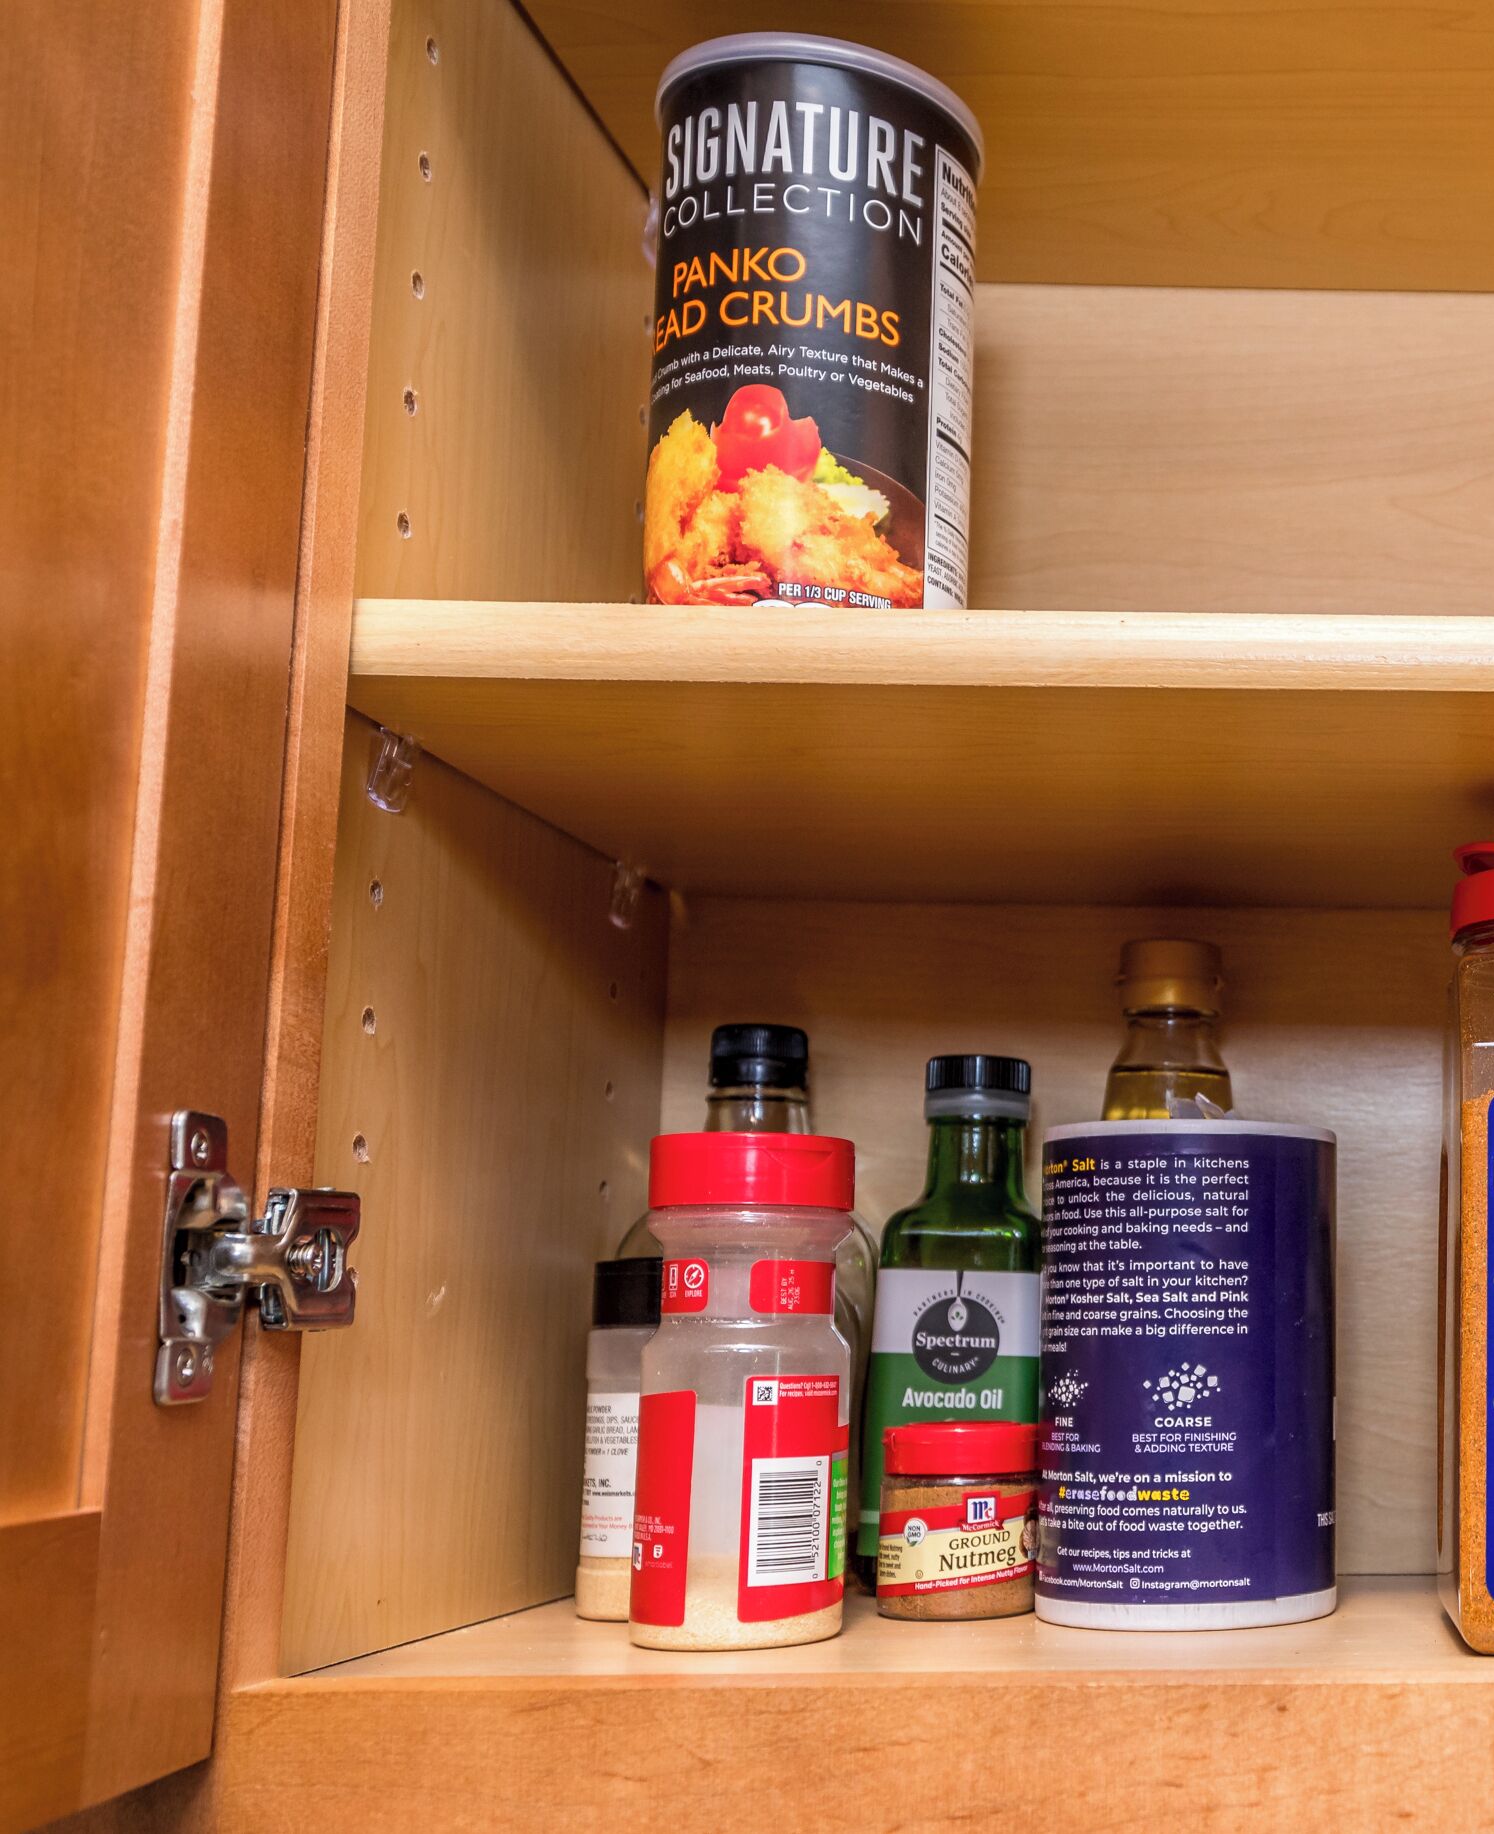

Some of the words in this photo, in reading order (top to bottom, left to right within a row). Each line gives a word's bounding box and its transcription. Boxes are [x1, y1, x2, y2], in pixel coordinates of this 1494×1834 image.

[666, 100, 925, 208] SIGNATURE
[664, 183, 921, 245] COLLECTION
[673, 247, 806, 298] PANKO
[655, 299, 707, 353] EAD
[719, 291, 900, 347] CRUMBS
[658, 359, 679, 380] Crumb
[681, 353, 700, 369] with
[703, 351, 710, 361] a
[712, 345, 764, 359] Delicate,
[768, 344, 795, 357] Airy
[799, 346, 848, 364] Texture
[851, 355, 878, 371] that
[880, 362, 915, 382] Makes
[917, 378, 924, 388] a
[671, 377, 682, 388] for
[684, 366, 730, 384] Seafood,
[733, 364, 774, 377] Meats,
[778, 364, 826, 381] Poultry
[830, 371, 844, 382] or
[848, 373, 914, 403] Vegetables
[778, 583, 801, 597] PER
[805, 586, 821, 599] 1/3
[824, 587, 846, 602] CUP
[849, 591, 891, 609] SERVING
[1072, 1157, 1096, 1172] Salt
[1100, 1159, 1109, 1170] is
[1115, 1161, 1122, 1170] a
[1127, 1157, 1167, 1172] staple
[1174, 1158, 1186, 1168] in
[1194, 1157, 1249, 1169] kitchens
[1070, 1293, 1103, 1305] Kosher
[1106, 1292, 1133, 1305] Salt,
[1135, 1292, 1159, 1303] Sea
[1162, 1292, 1188, 1303] Salt
[1191, 1292, 1216, 1303] and
[1220, 1291, 1248, 1302] Pink
[1169, 1324, 1234, 1336] difference
[916, 1331, 996, 1350] Spectrum
[902, 1387, 976, 1409] Avocado
[981, 1389, 1003, 1410] Oil
[1055, 1417, 1073, 1428] FINE
[1154, 1417, 1212, 1428] COARSE
[1132, 1433, 1157, 1443] BEST
[1160, 1432, 1182, 1442] FOR
[1184, 1432, 1237, 1442] FINISHING
[1143, 1443, 1186, 1453] ADDING
[1188, 1442, 1234, 1453] TEXTURE
[598, 1478, 611, 1488] INC.
[1098, 1471, 1130, 1483] we're
[1133, 1473, 1150, 1483] on
[1153, 1473, 1161, 1483] a
[1164, 1471, 1215, 1483] mission
[1218, 1471, 1232, 1482] to
[1058, 1486, 1190, 1502] #erasefoodwaste
[962, 1520, 999, 1532] McCormick
[949, 1530, 1010, 1550] GROUND
[939, 1545, 1016, 1572] Nutmeg
[1072, 1562, 1164, 1574] www.MortonSalt.com
[915, 1580, 958, 1591] Hand-Picked
[971, 1574, 995, 1583] Intense
[996, 1570, 1014, 1580] Nutty
[1141, 1577, 1250, 1590] Instagram@mortonsalt
